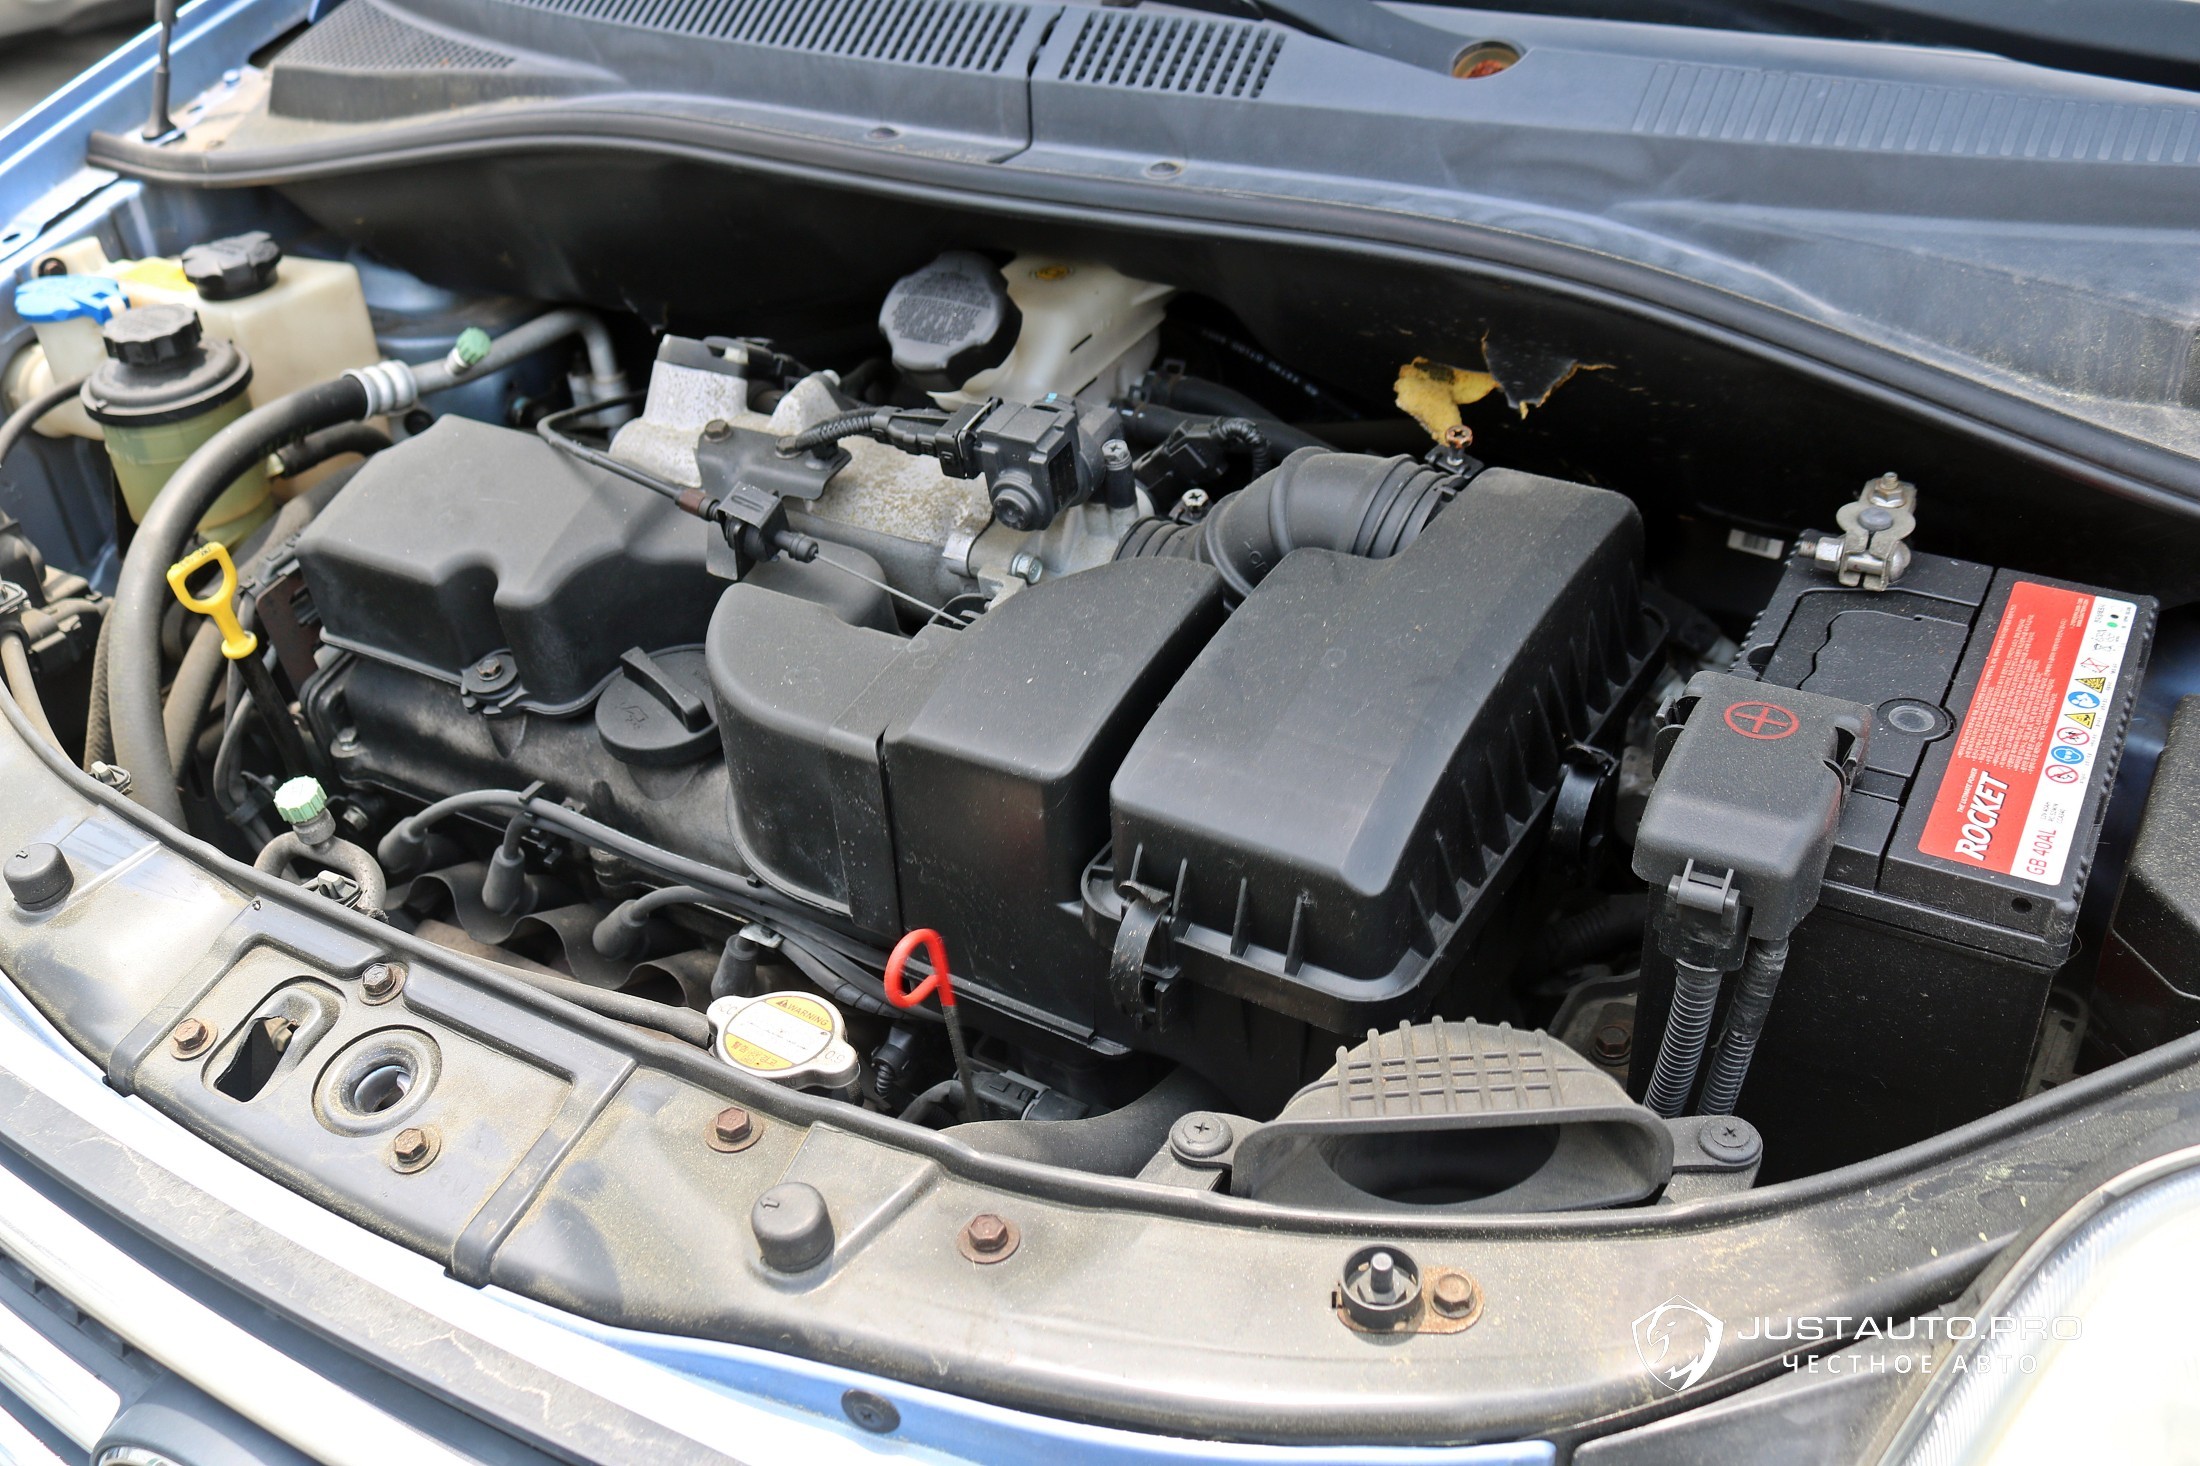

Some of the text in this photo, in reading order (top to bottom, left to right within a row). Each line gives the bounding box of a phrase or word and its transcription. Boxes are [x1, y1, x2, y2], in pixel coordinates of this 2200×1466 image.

[1954, 771, 2010, 861] ROCKET
[2026, 829, 2057, 876] GB 40AL
[787, 1003, 829, 1027] WARNING
